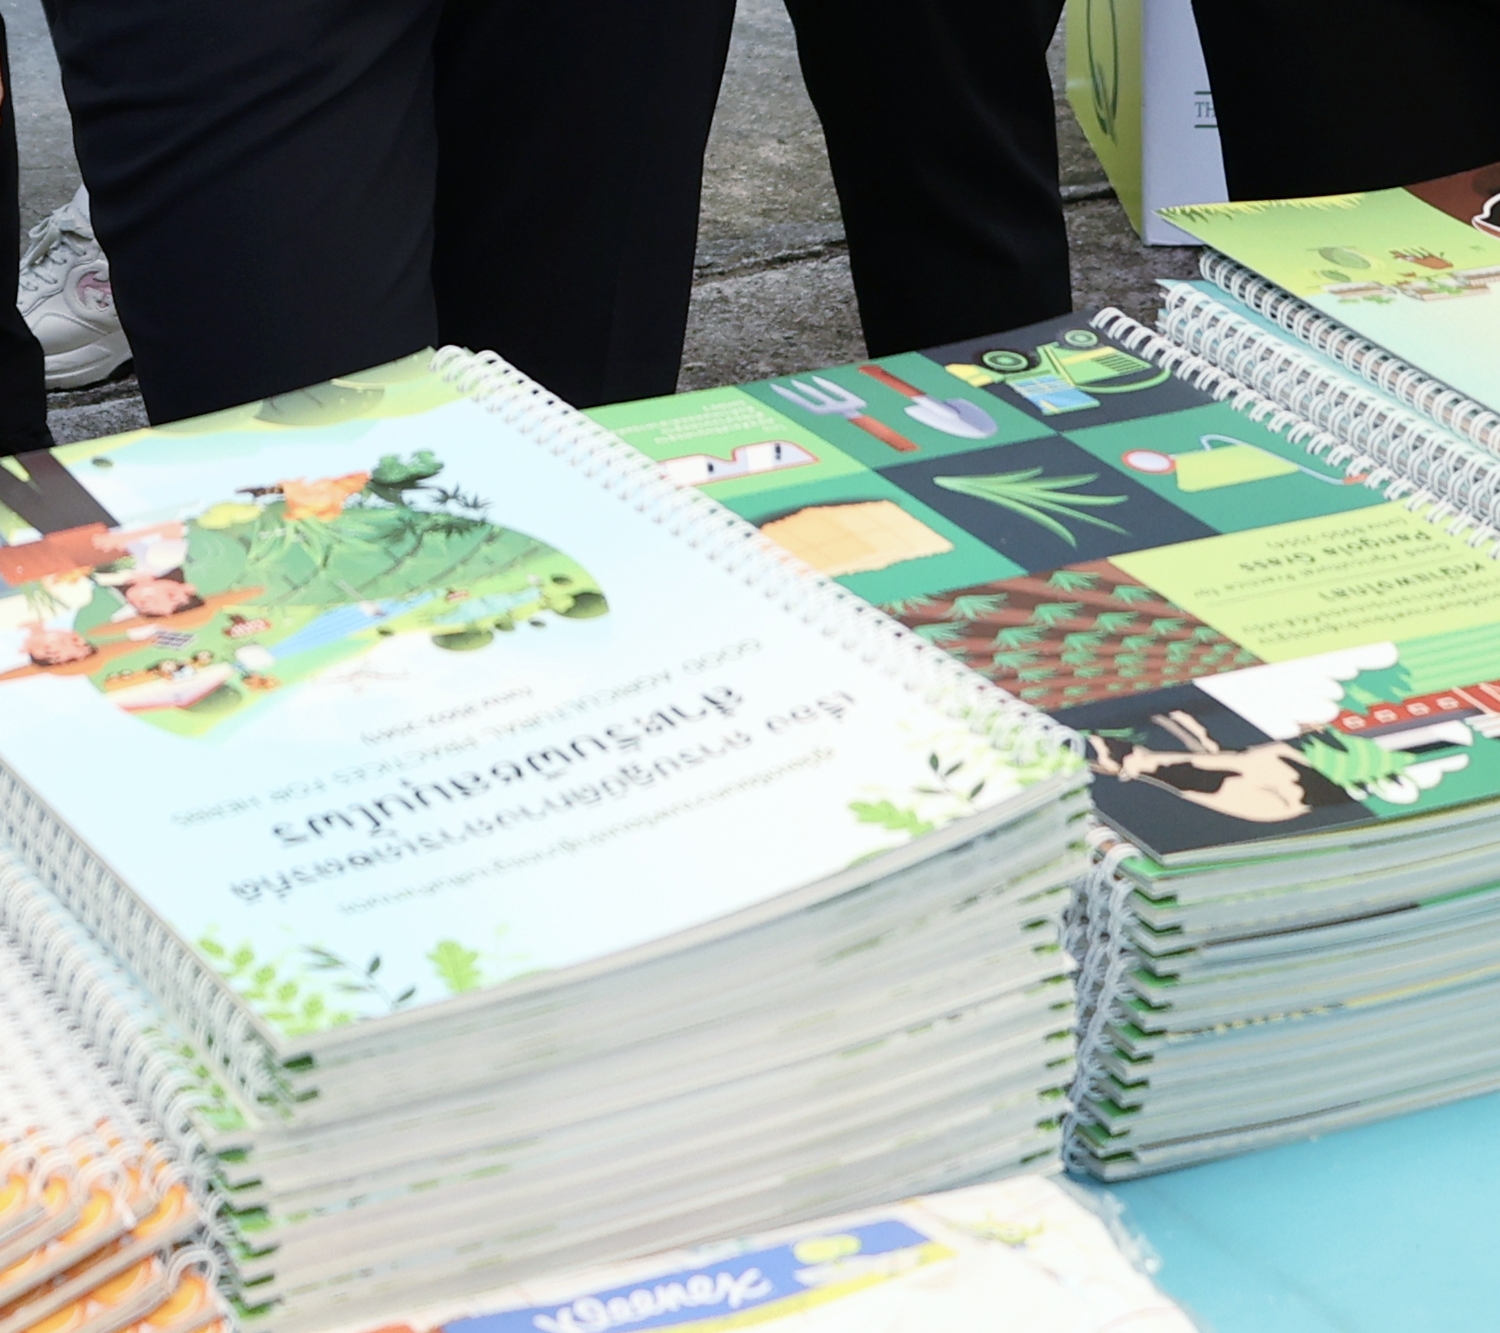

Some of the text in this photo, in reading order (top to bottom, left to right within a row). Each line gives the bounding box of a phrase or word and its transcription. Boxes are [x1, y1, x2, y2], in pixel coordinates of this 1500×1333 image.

[1237, 521, 1430, 576] Pangola Grass
[679, 635, 761, 676] GOOD
[484, 665, 672, 745] AGRICULTURAL
[269, 679, 743, 861] สำหรับพืชสมุนไพร
[333, 730, 480, 789] PRACTICES
[267, 773, 327, 807] FOR
